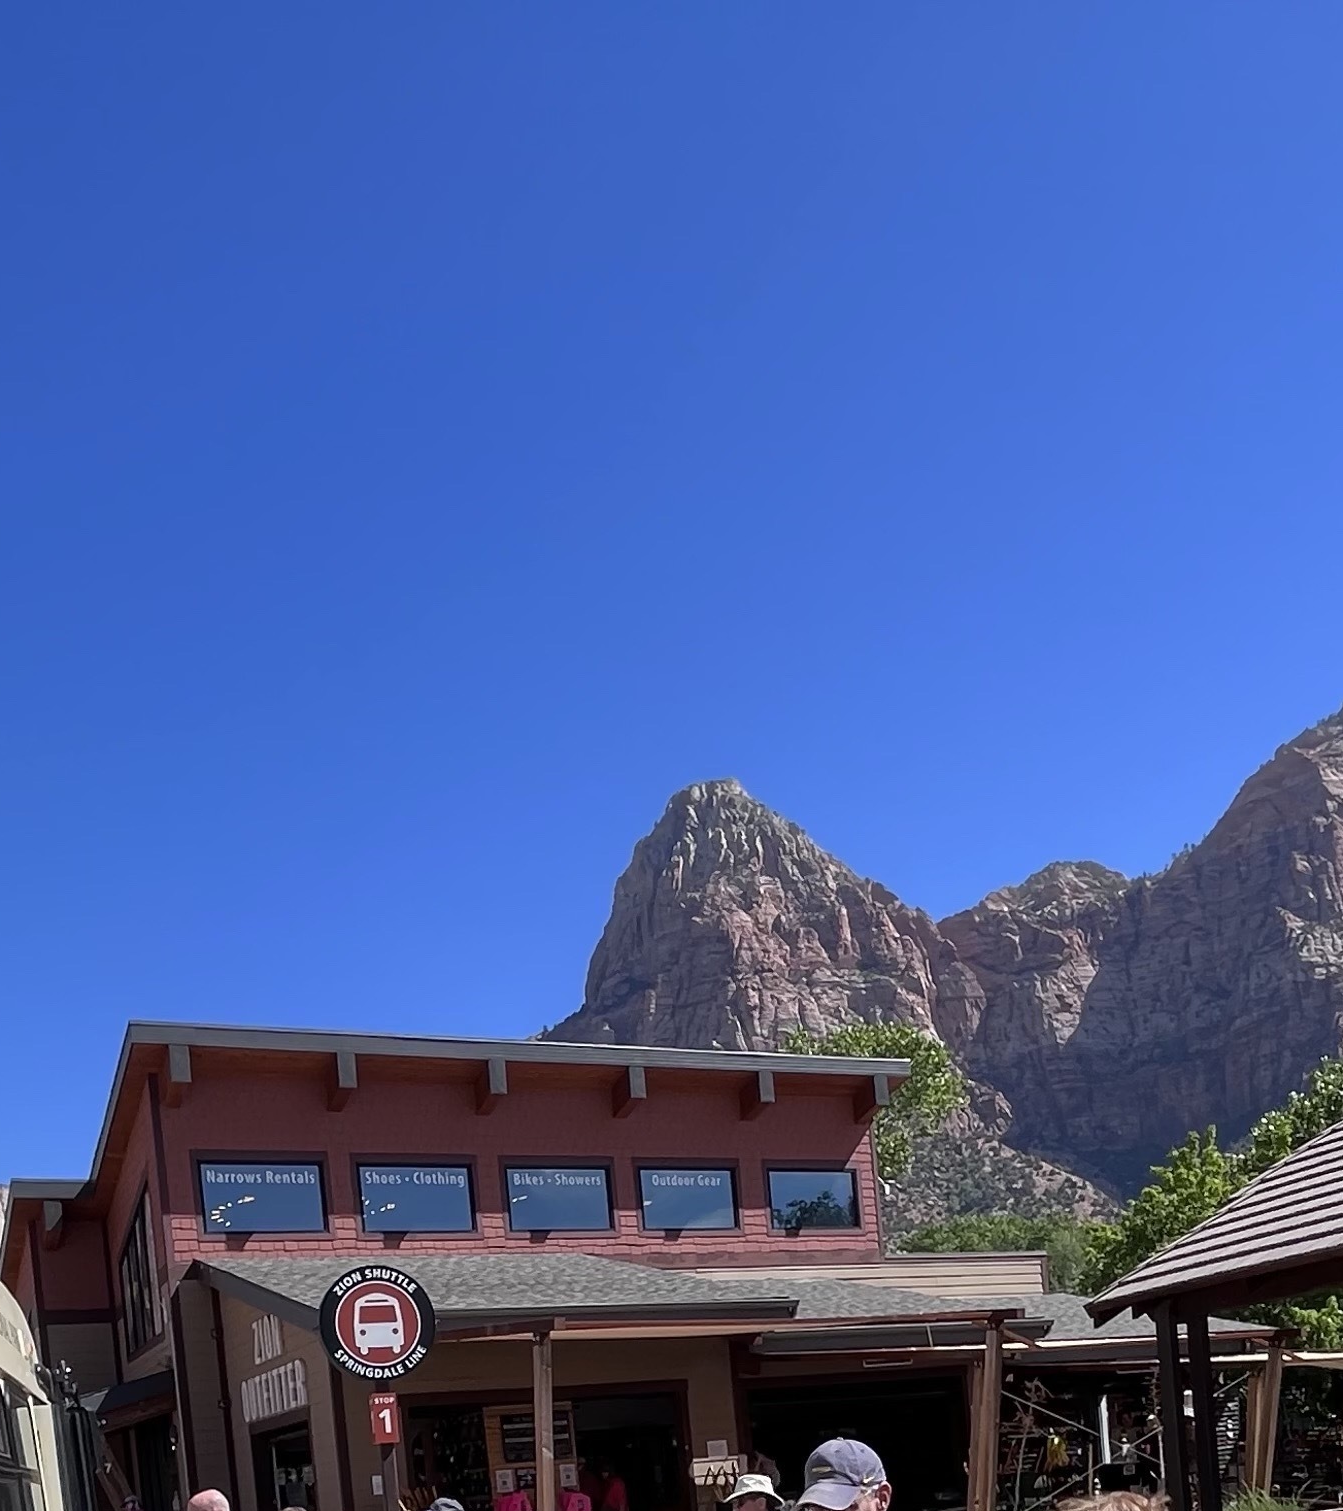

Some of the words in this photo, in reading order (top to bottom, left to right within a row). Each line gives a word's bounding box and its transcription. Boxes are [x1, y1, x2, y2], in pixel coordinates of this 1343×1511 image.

[206, 1169, 262, 1184] Narrows
[265, 1170, 316, 1184] Rentals
[364, 1171, 402, 1185] Shoes
[412, 1171, 466, 1188] Clothing
[512, 1173, 545, 1186] Bikes
[553, 1173, 602, 1187] Showers
[651, 1174, 695, 1187] Outdoor
[696, 1174, 722, 1187] Gear
[332, 1271, 362, 1296] ZION
[364, 1268, 417, 1294] SHUTTLE
[251, 1313, 283, 1366] ZION
[333, 1349, 405, 1379] SPRINGDALE
[404, 1344, 428, 1369] LINE
[240, 1358, 308, 1424] OUTFITTER
[373, 1396, 396, 1405] STOP
[377, 1407, 392, 1434] 1
